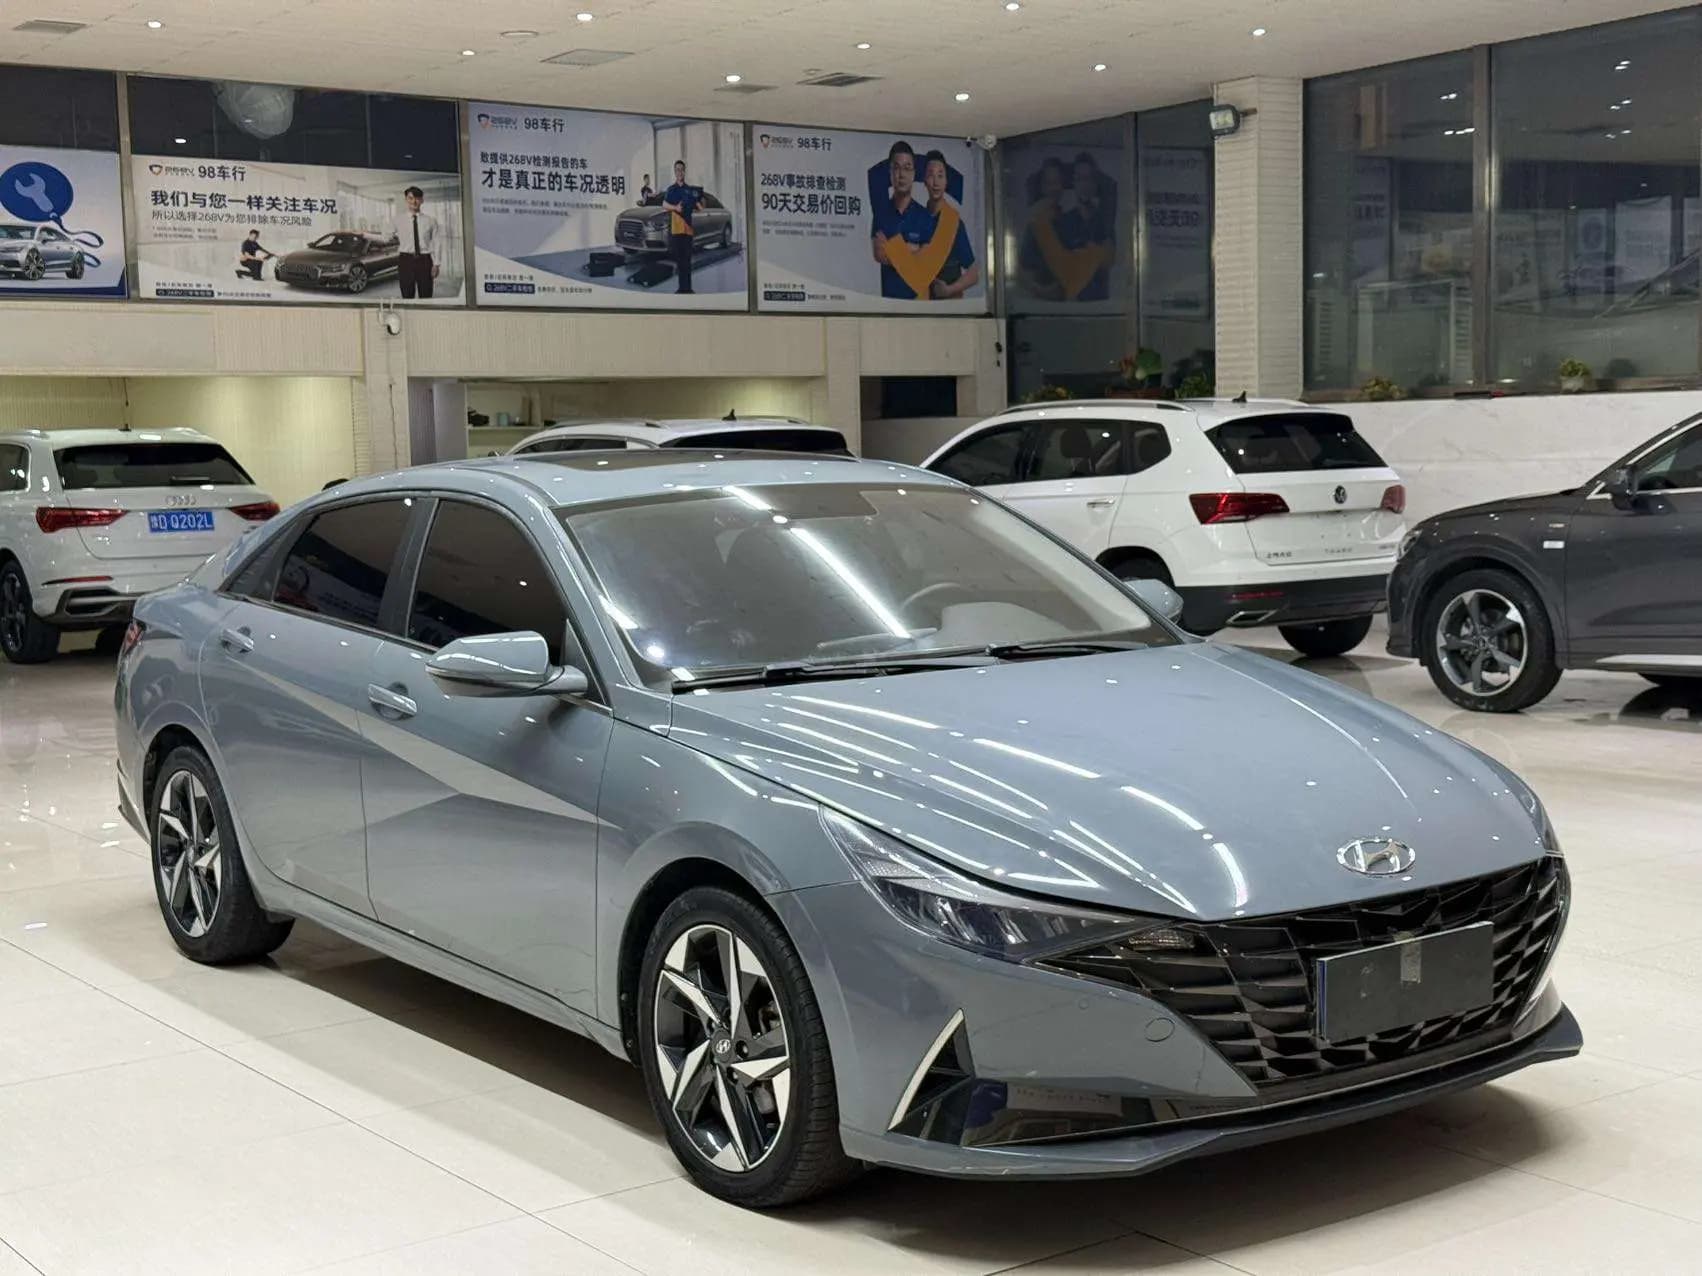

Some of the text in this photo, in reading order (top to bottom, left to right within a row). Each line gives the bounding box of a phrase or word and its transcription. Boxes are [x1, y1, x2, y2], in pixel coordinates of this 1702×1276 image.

[524, 117, 565, 133] 98车行
[797, 136, 832, 151] 98车行
[480, 151, 588, 170] 敢提供268V检测报告的车
[198, 165, 246, 182] 98车行
[481, 167, 626, 195] 才是真正的车况透明
[760, 173, 847, 192] 268V事故排查检测
[151, 189, 338, 214] 我们与您一样关注车况
[761, 192, 862, 216] 90天交易价回购
[151, 210, 313, 227] 所以选择268V为您排除车况风险
